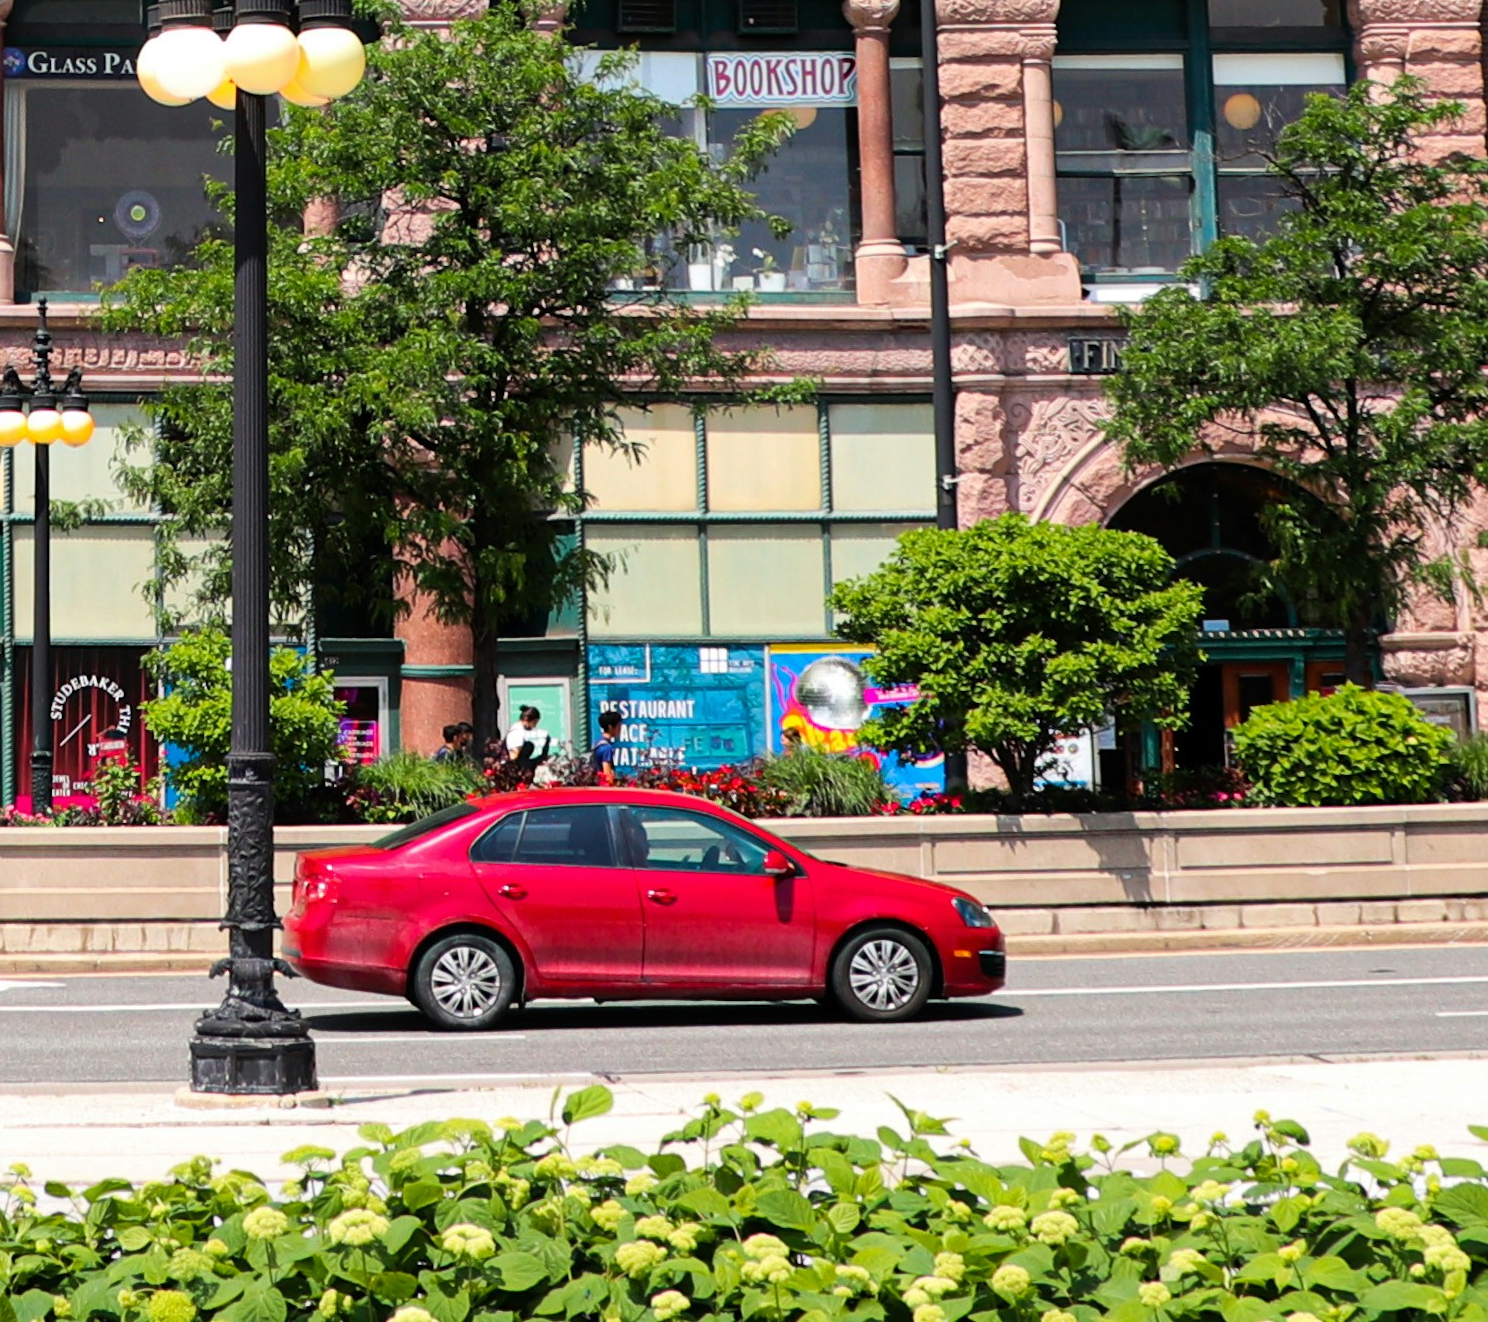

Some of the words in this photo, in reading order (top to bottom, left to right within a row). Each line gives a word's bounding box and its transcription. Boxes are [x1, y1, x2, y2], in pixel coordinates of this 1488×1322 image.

[27, 51, 97, 75] GLASS
[712, 58, 856, 97] BOOKSHOP
[1083, 340, 1124, 370] FIN
[50, 675, 125, 720] STUDEBAKER
